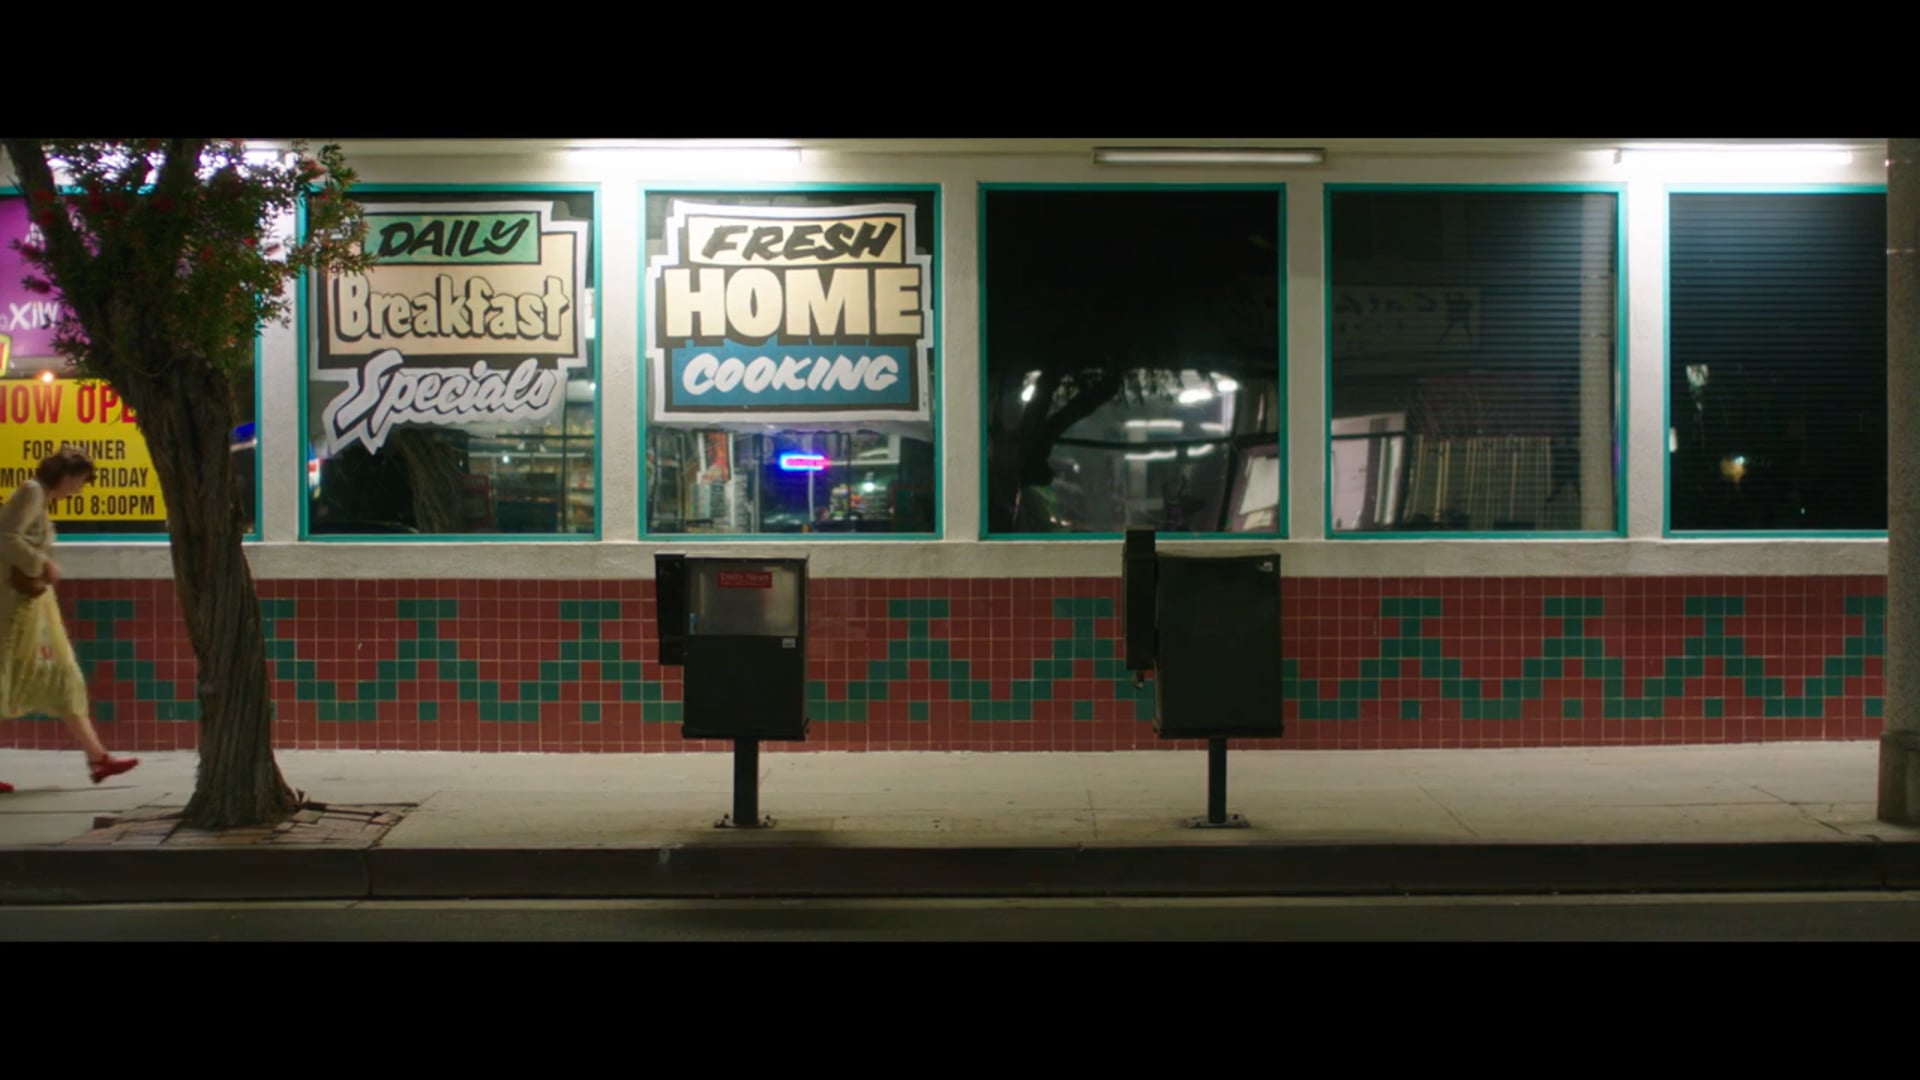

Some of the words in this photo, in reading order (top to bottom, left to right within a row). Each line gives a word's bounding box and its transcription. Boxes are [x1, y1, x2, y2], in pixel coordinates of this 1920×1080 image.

[377, 215, 530, 257] DAILY
[701, 222, 897, 261] FRESH
[335, 273, 571, 342] Breakfast
[663, 267, 923, 338] HOME
[333, 348, 558, 440] Specials
[682, 352, 899, 396] COOKING
[76, 384, 138, 424] OPE
[23, 440, 54, 460] FOR
[66, 495, 84, 515] TO
[90, 495, 155, 515] 8:00PM
